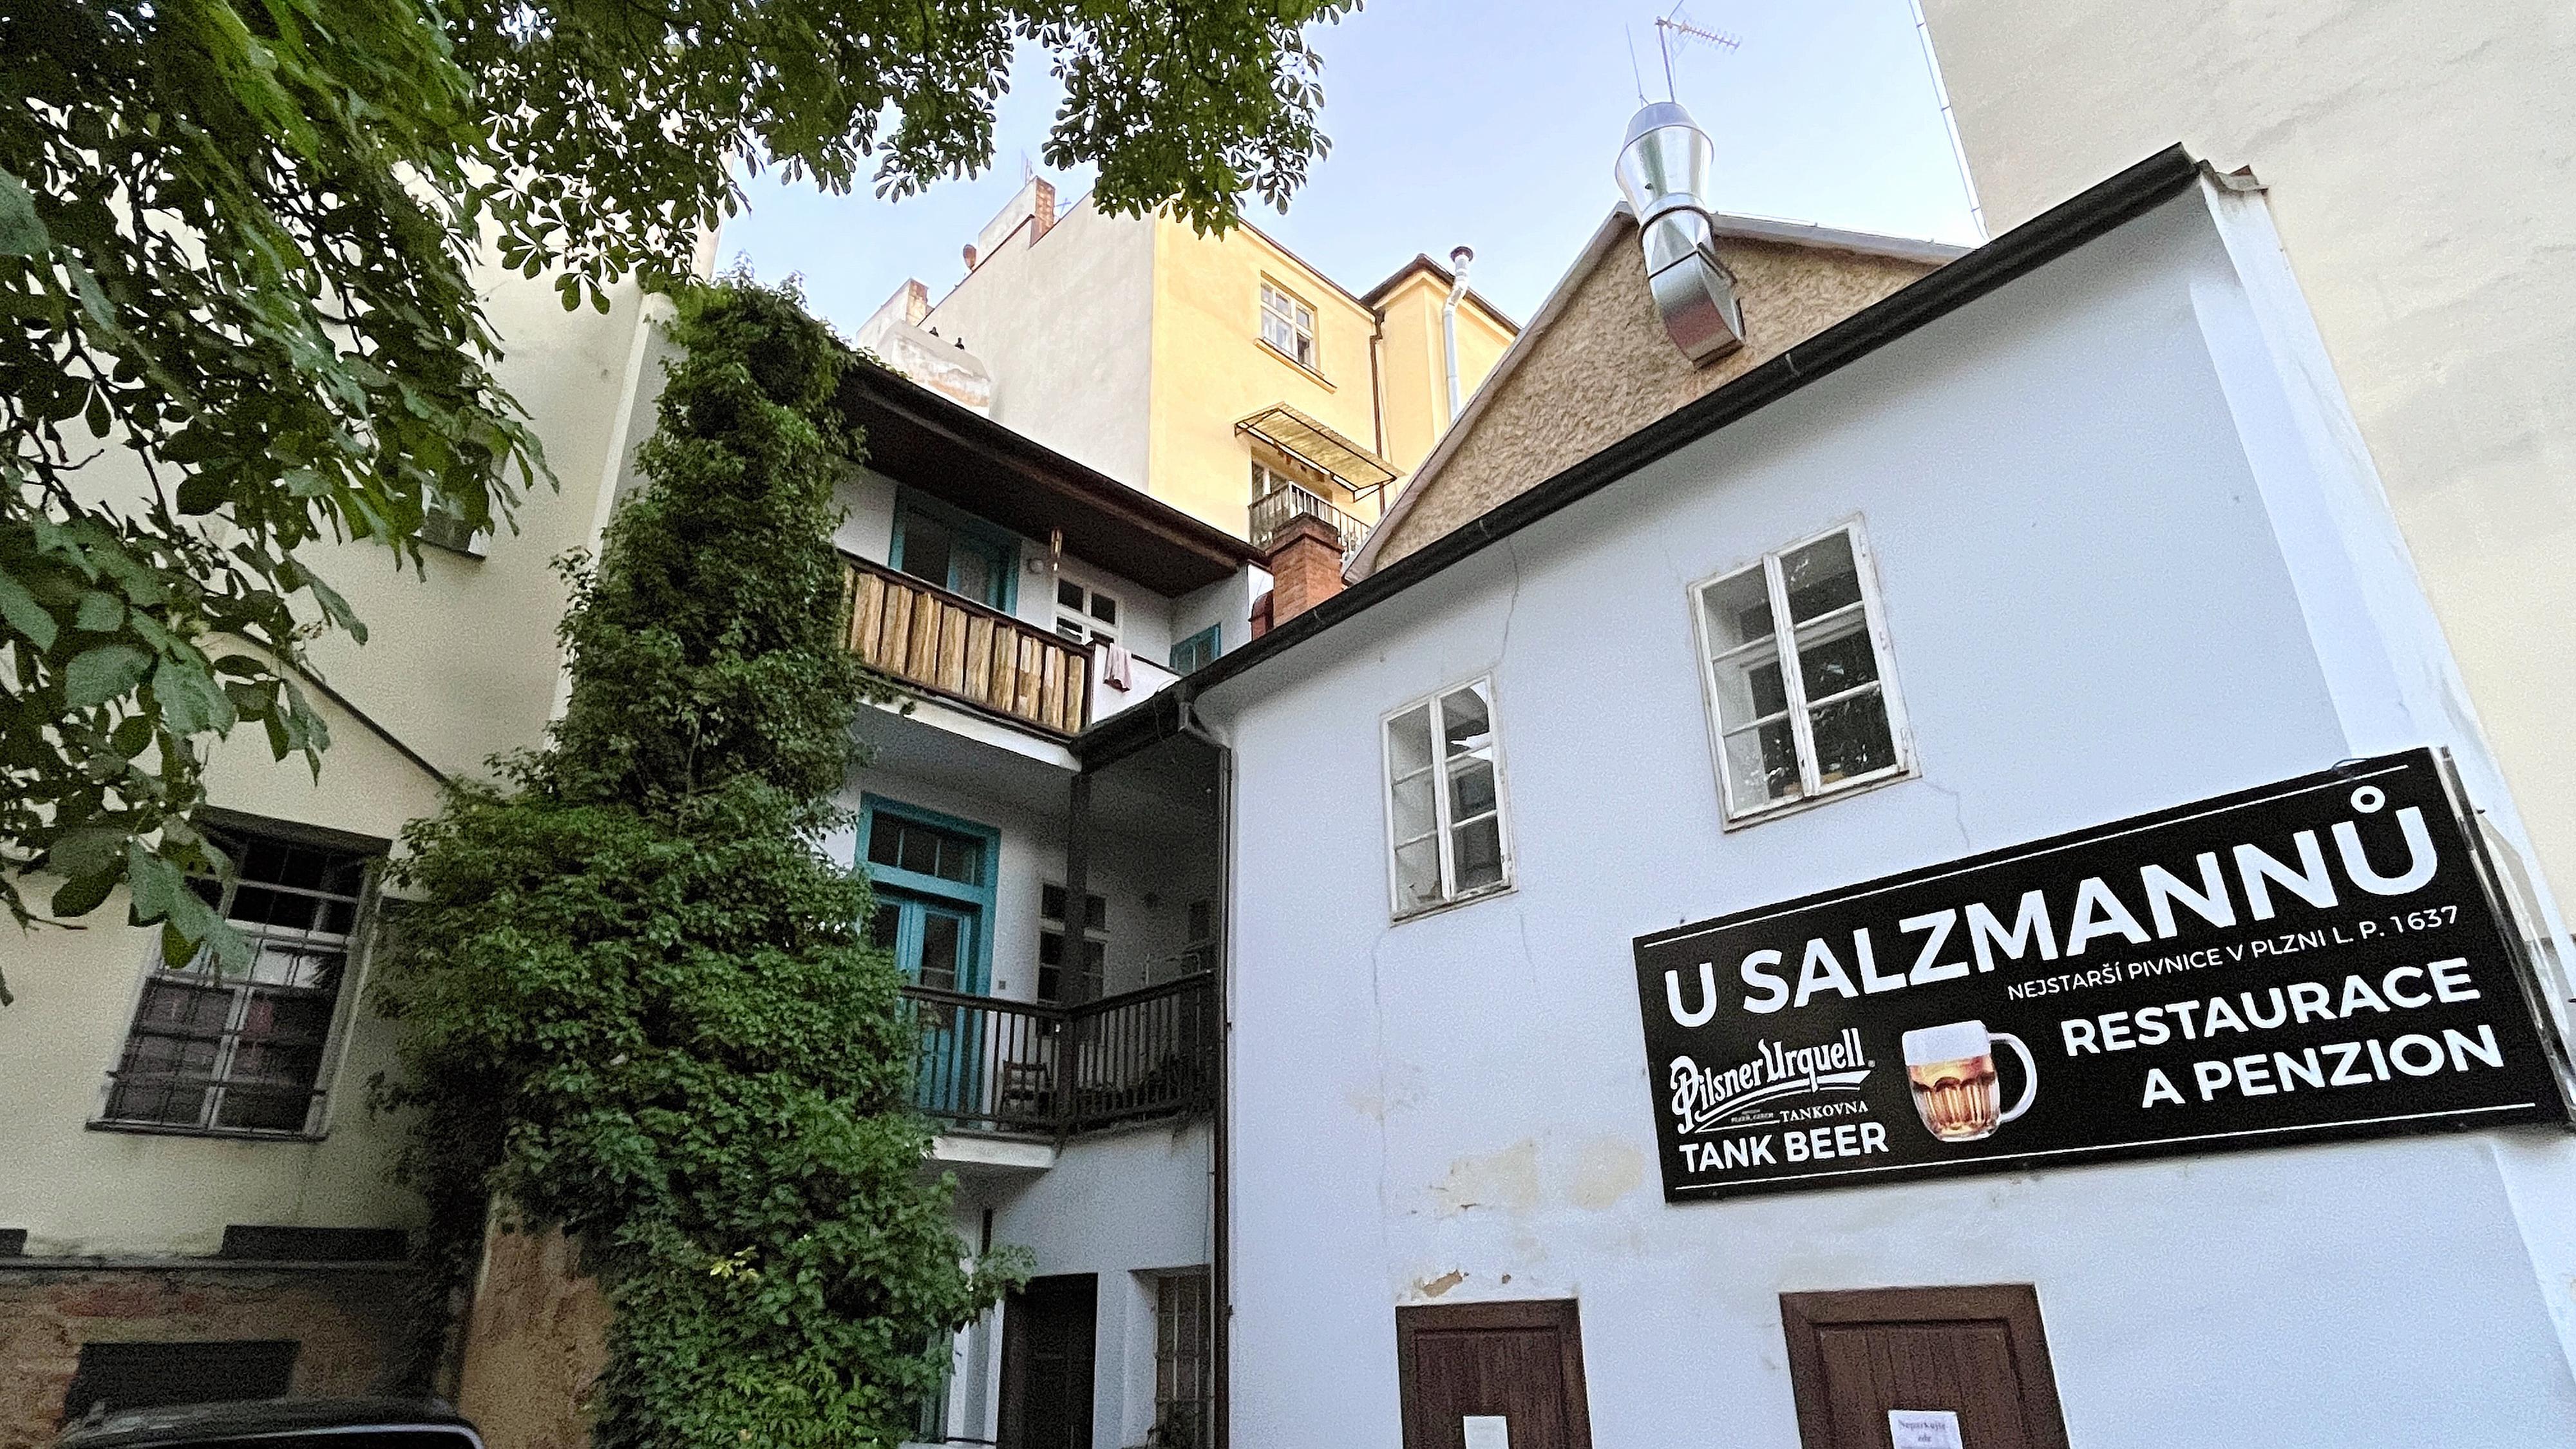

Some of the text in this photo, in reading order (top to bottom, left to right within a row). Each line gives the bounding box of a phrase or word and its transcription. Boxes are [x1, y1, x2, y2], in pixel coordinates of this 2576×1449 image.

[1664, 785, 2438, 1028] U SALZMANNŮ
[2007, 961, 2123, 1001] NEJSTARŠÍ
[2127, 948, 2224, 980] PIVNICE
[2226, 943, 2244, 961] V
[2251, 929, 2327, 958] PLZNI
[2358, 920, 2385, 940] P.
[2389, 905, 2458, 934] 1637
[2060, 957, 2481, 1057] RESTAURACE
[1669, 1027, 1866, 1135] Pilsner Urquell
[1779, 1100, 1869, 1123] TANKOVNA
[2141, 1024, 2505, 1108] A PENZION
[1678, 1121, 1890, 1173] TANK BEER
